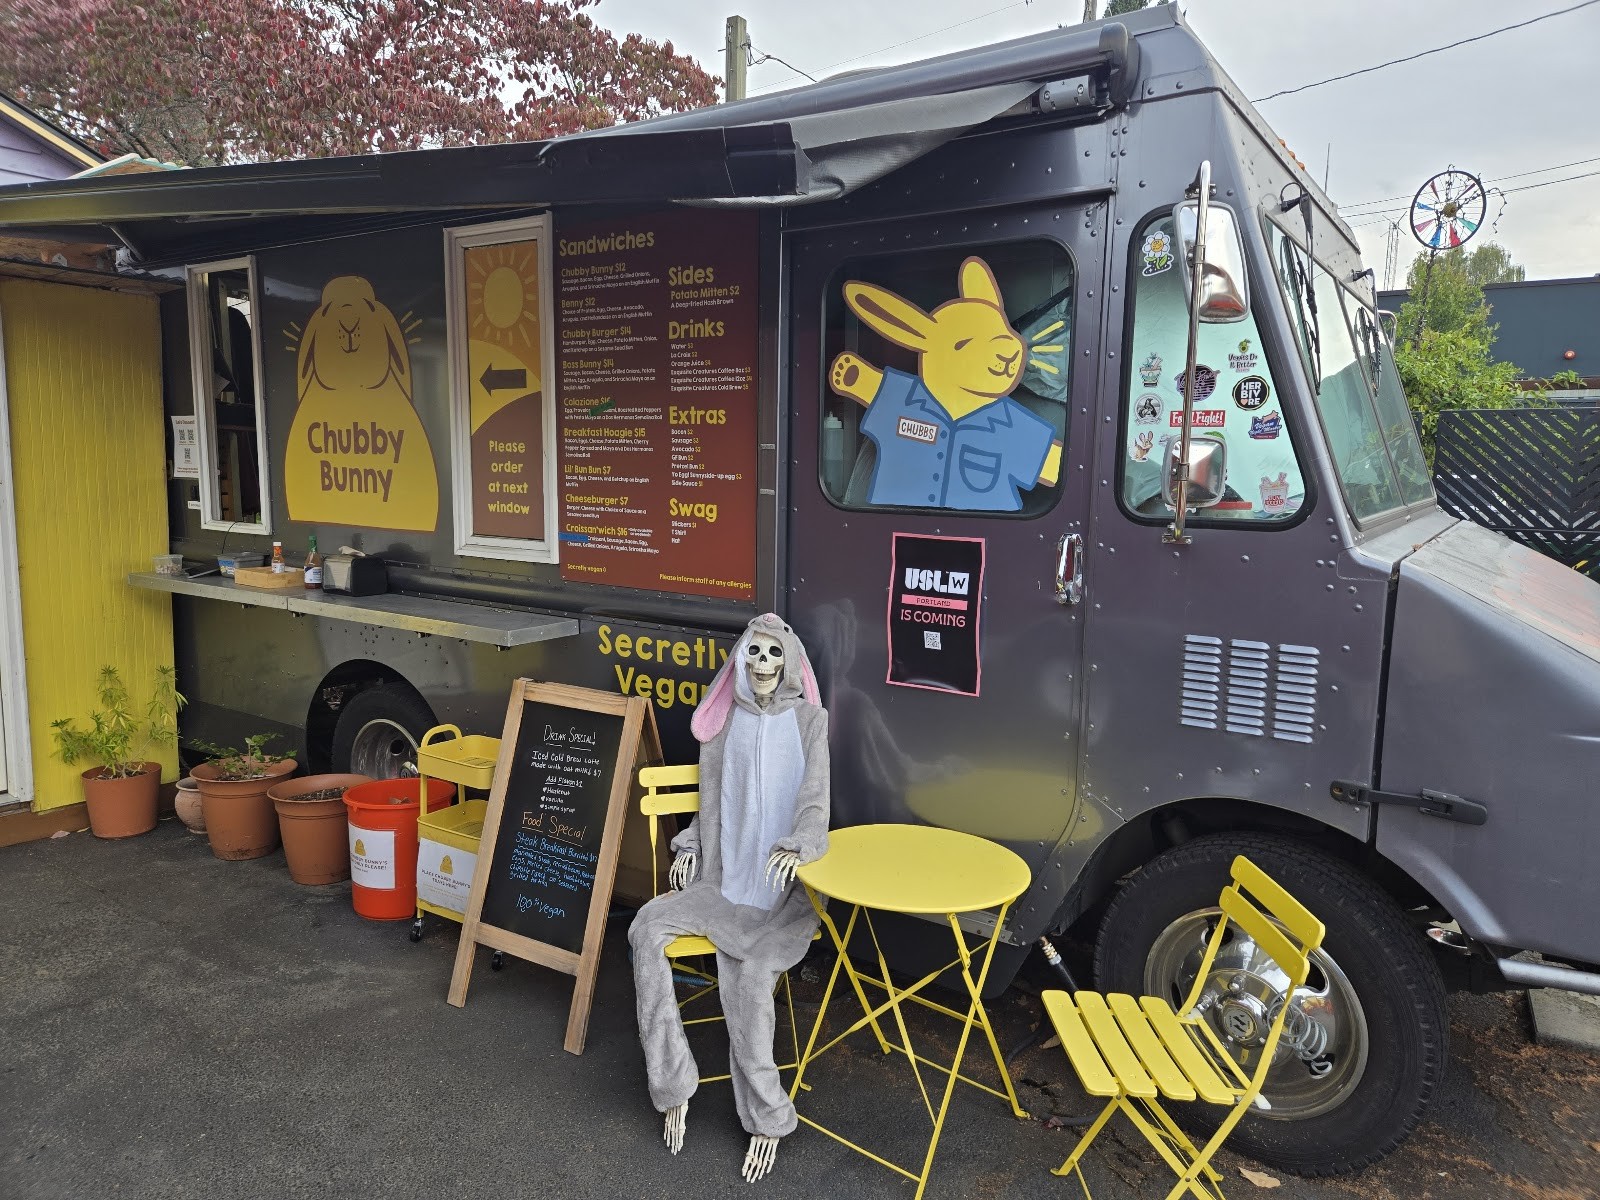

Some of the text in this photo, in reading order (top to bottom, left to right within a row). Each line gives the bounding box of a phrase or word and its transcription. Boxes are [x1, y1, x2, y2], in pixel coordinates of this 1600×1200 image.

[559, 231, 655, 257] Sandwiches
[561, 262, 626, 277] Chubby Bunny $12
[668, 265, 714, 287] Sides
[671, 285, 740, 300] Potato Mitten $2
[561, 297, 596, 309] Benny $12
[562, 326, 631, 339] Chubby Burger $14
[668, 318, 725, 340] Drinks
[562, 359, 614, 369] Boss Bunny $14
[1241, 381, 1261, 390] HER
[563, 397, 599, 406] Colazione
[1240, 390, 1260, 399] BIV
[669, 405, 727, 425] Extras
[1196, 411, 1224, 427] Fight!
[563, 428, 646, 438] Breakfast Hoagie $15
[901, 421, 934, 440] CHUBBS
[307, 421, 405, 464] Chubby
[489, 440, 526, 454] Please
[491, 461, 524, 474] order
[574, 465, 588, 474] Bun
[588, 465, 602, 474] Bun
[602, 466, 612, 475] $7
[320, 460, 393, 503] Bunny
[488, 481, 529, 494] at next
[565, 494, 629, 506] Cheeseburger $7
[488, 501, 530, 515] window
[669, 497, 718, 523] Swag
[567, 563, 587, 572] Secretly
[916, 597, 951, 608] PORTLAND
[900, 609, 966, 628] IS COMING
[531, 750, 549, 761] Iced
[550, 753, 565, 762] Cold
[566, 755, 582, 763] Brew
[531, 761, 546, 769] made
[522, 811, 587, 841] Food Special
[515, 831, 539, 848] Steak
